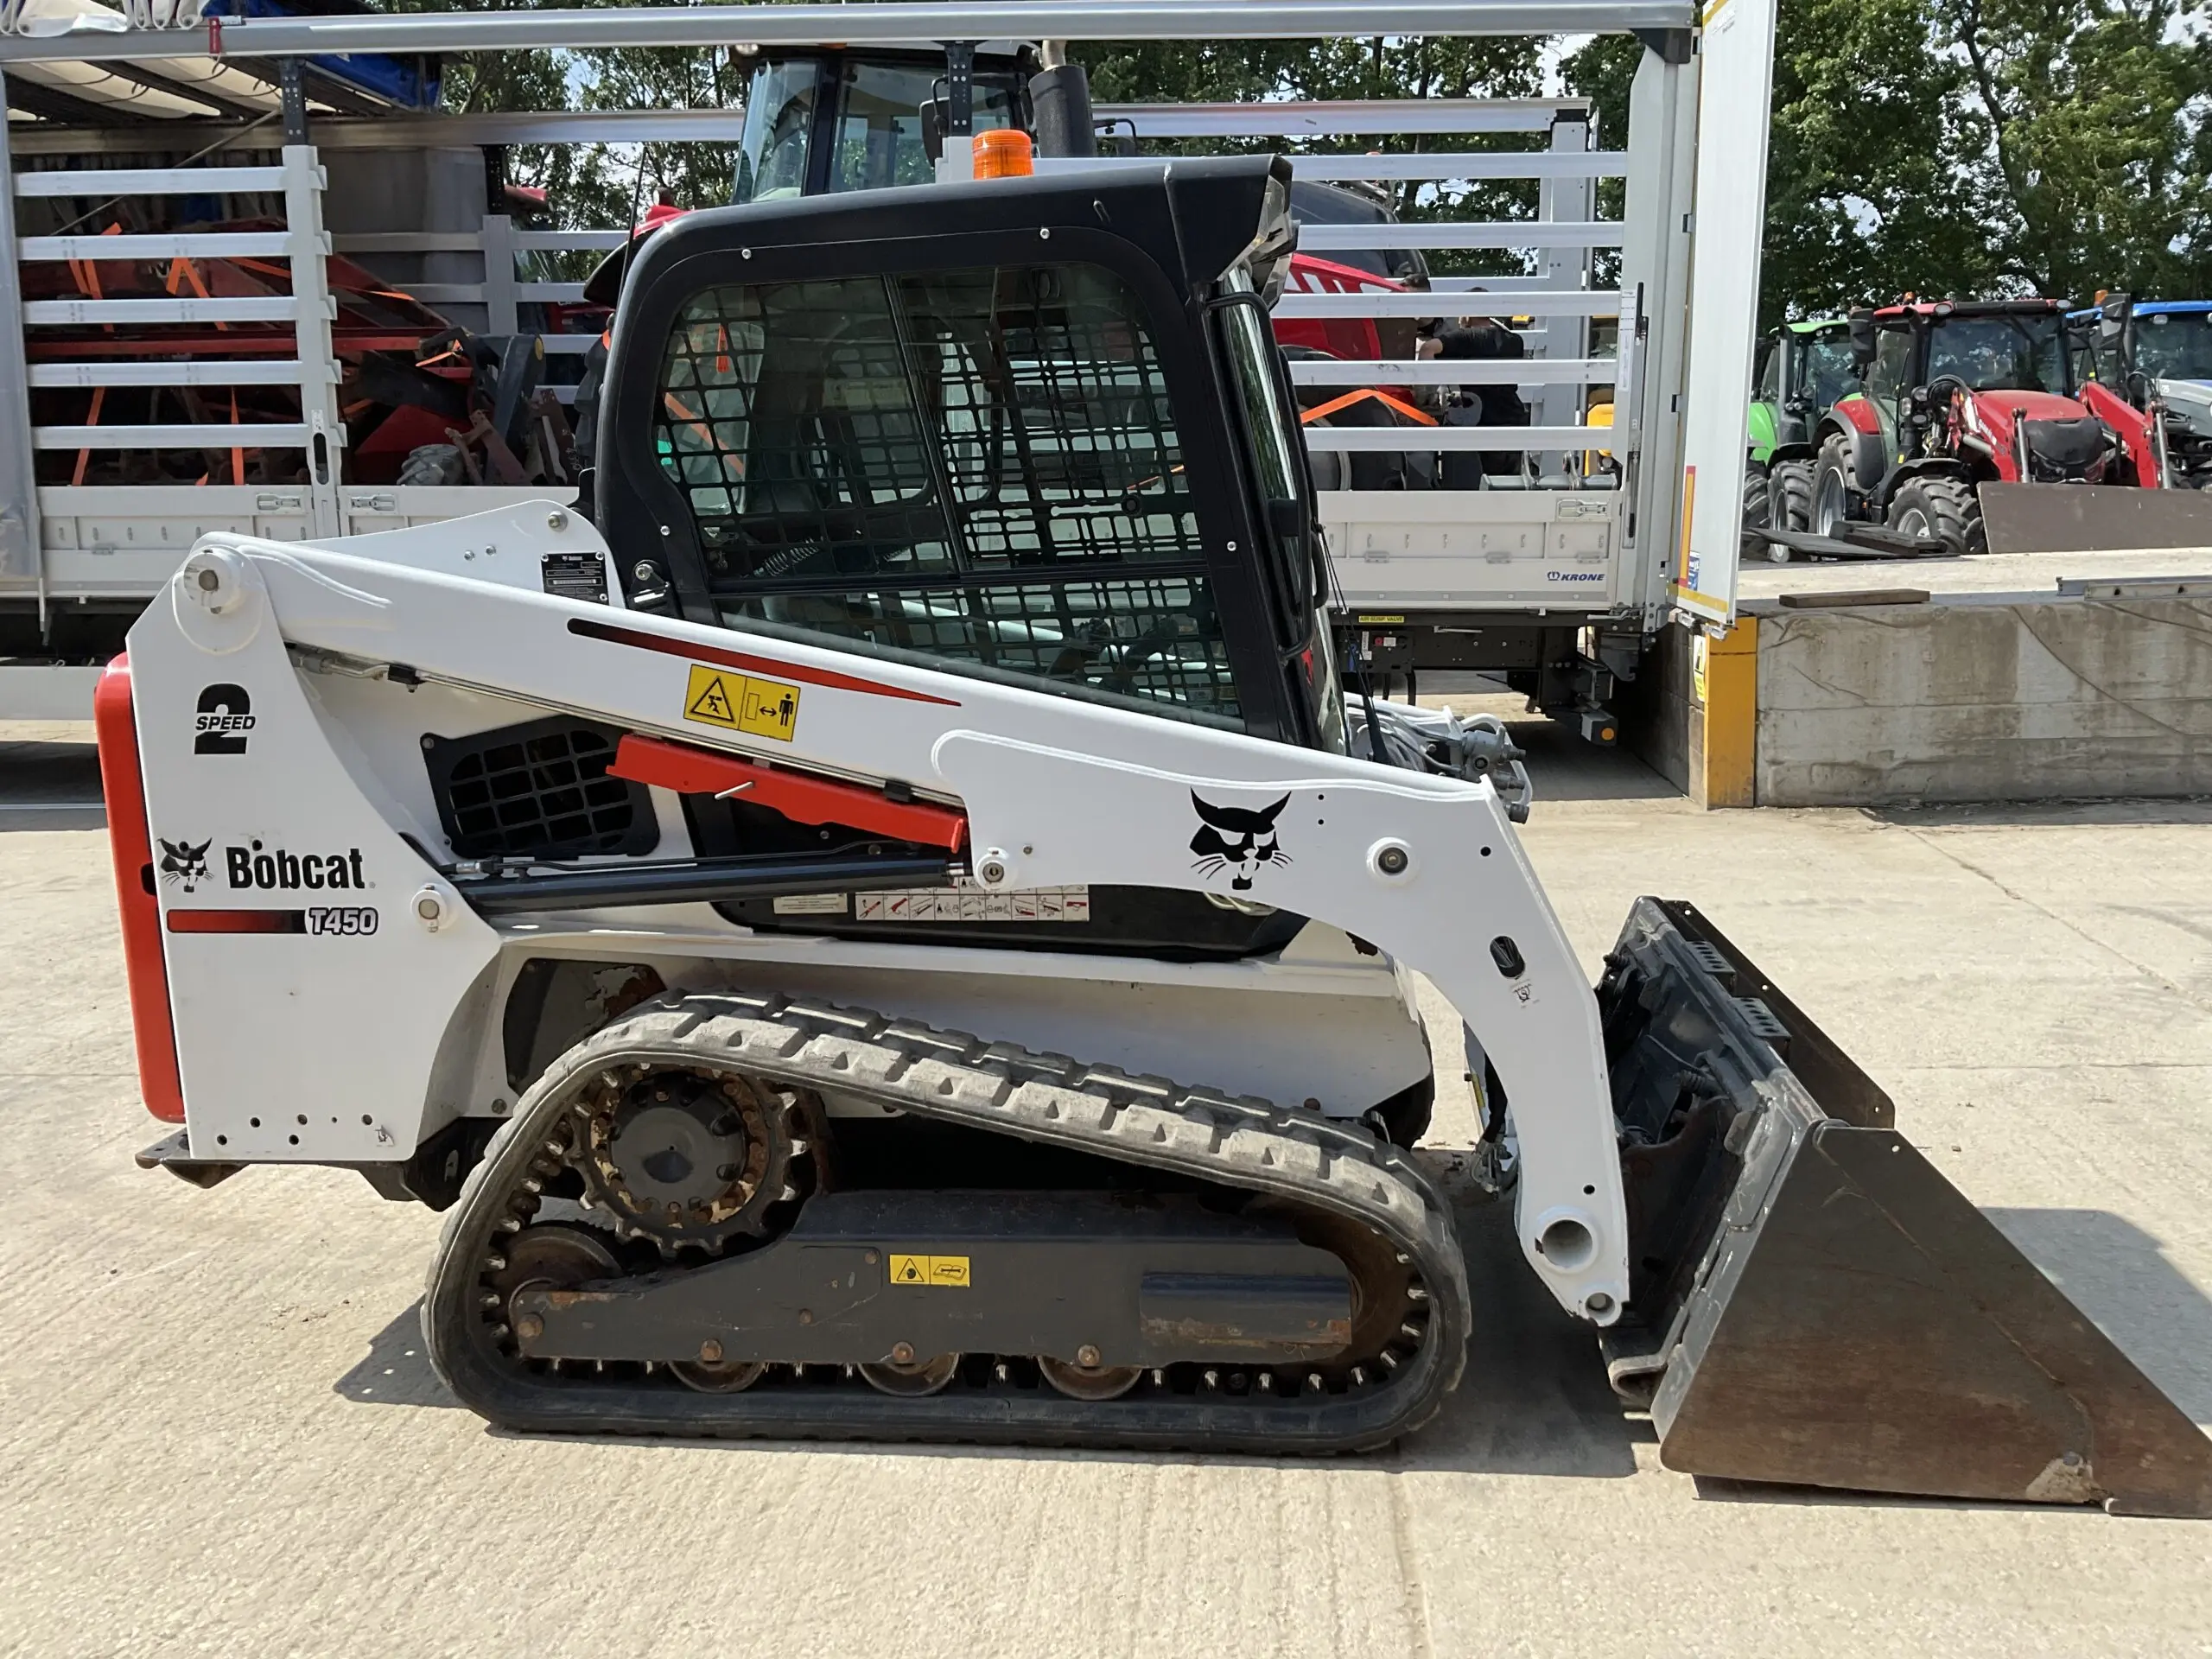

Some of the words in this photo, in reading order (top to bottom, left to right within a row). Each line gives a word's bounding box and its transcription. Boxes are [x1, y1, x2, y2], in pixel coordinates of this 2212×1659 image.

[194, 683, 251, 754] 2
[195, 715, 256, 730] SPEED
[226, 847, 365, 889] Bobcat
[308, 907, 378, 935] T450
